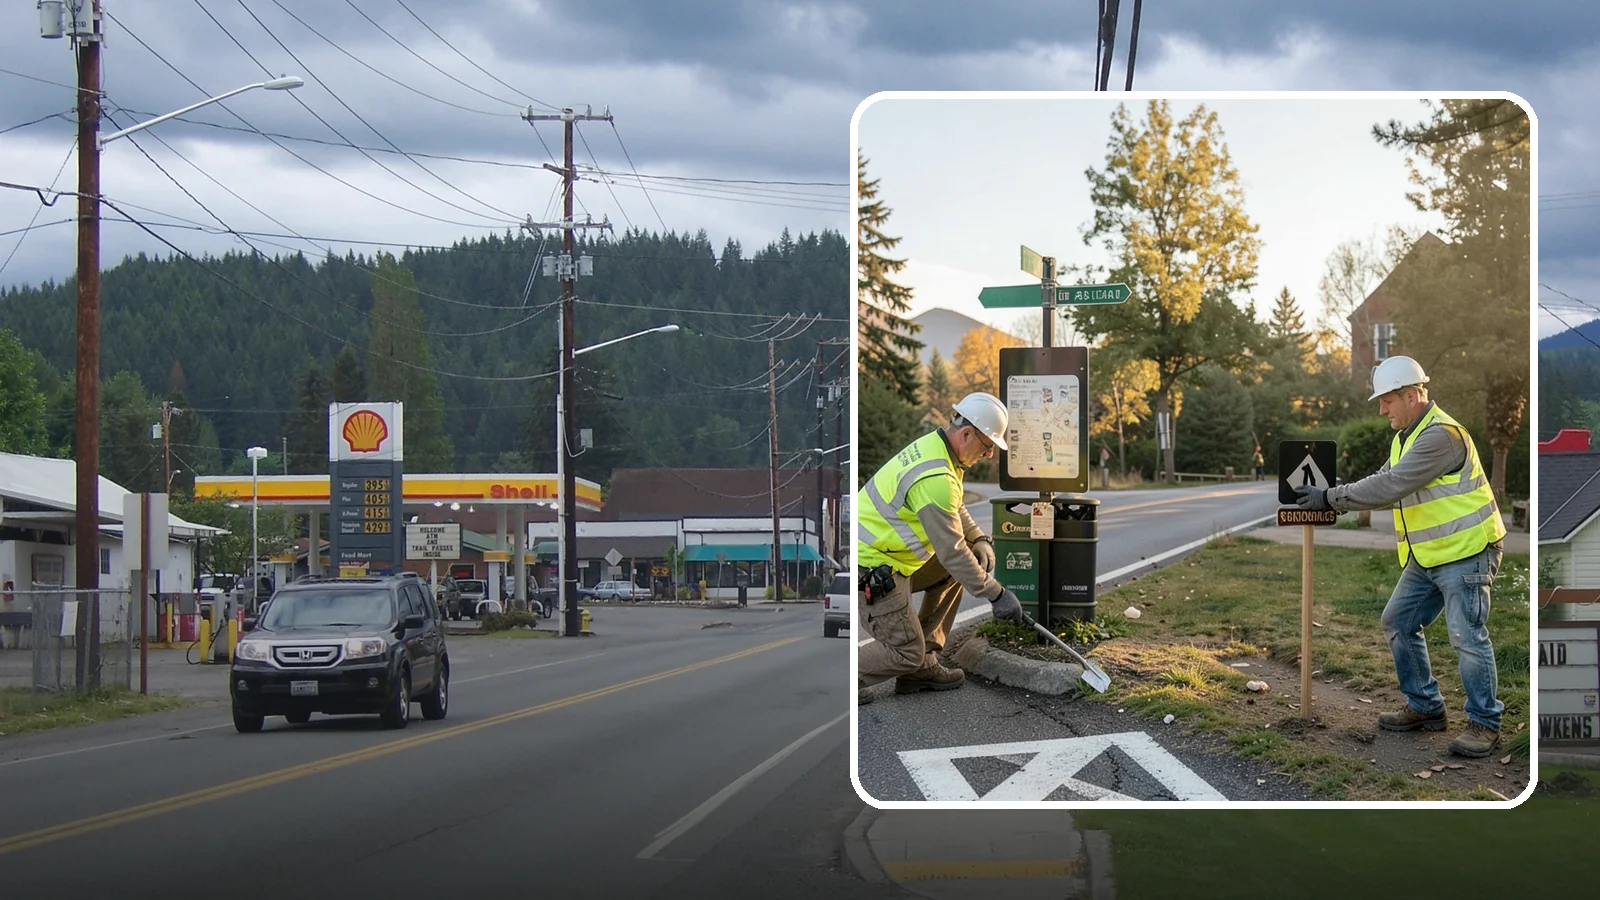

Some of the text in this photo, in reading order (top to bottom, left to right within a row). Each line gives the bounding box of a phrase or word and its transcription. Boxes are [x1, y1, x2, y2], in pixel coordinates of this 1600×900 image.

[366, 480, 383, 490] 395
[490, 484, 547, 498] Shell
[366, 494, 383, 504] 405
[366, 508, 383, 518] 415
[366, 522, 383, 532] 429
